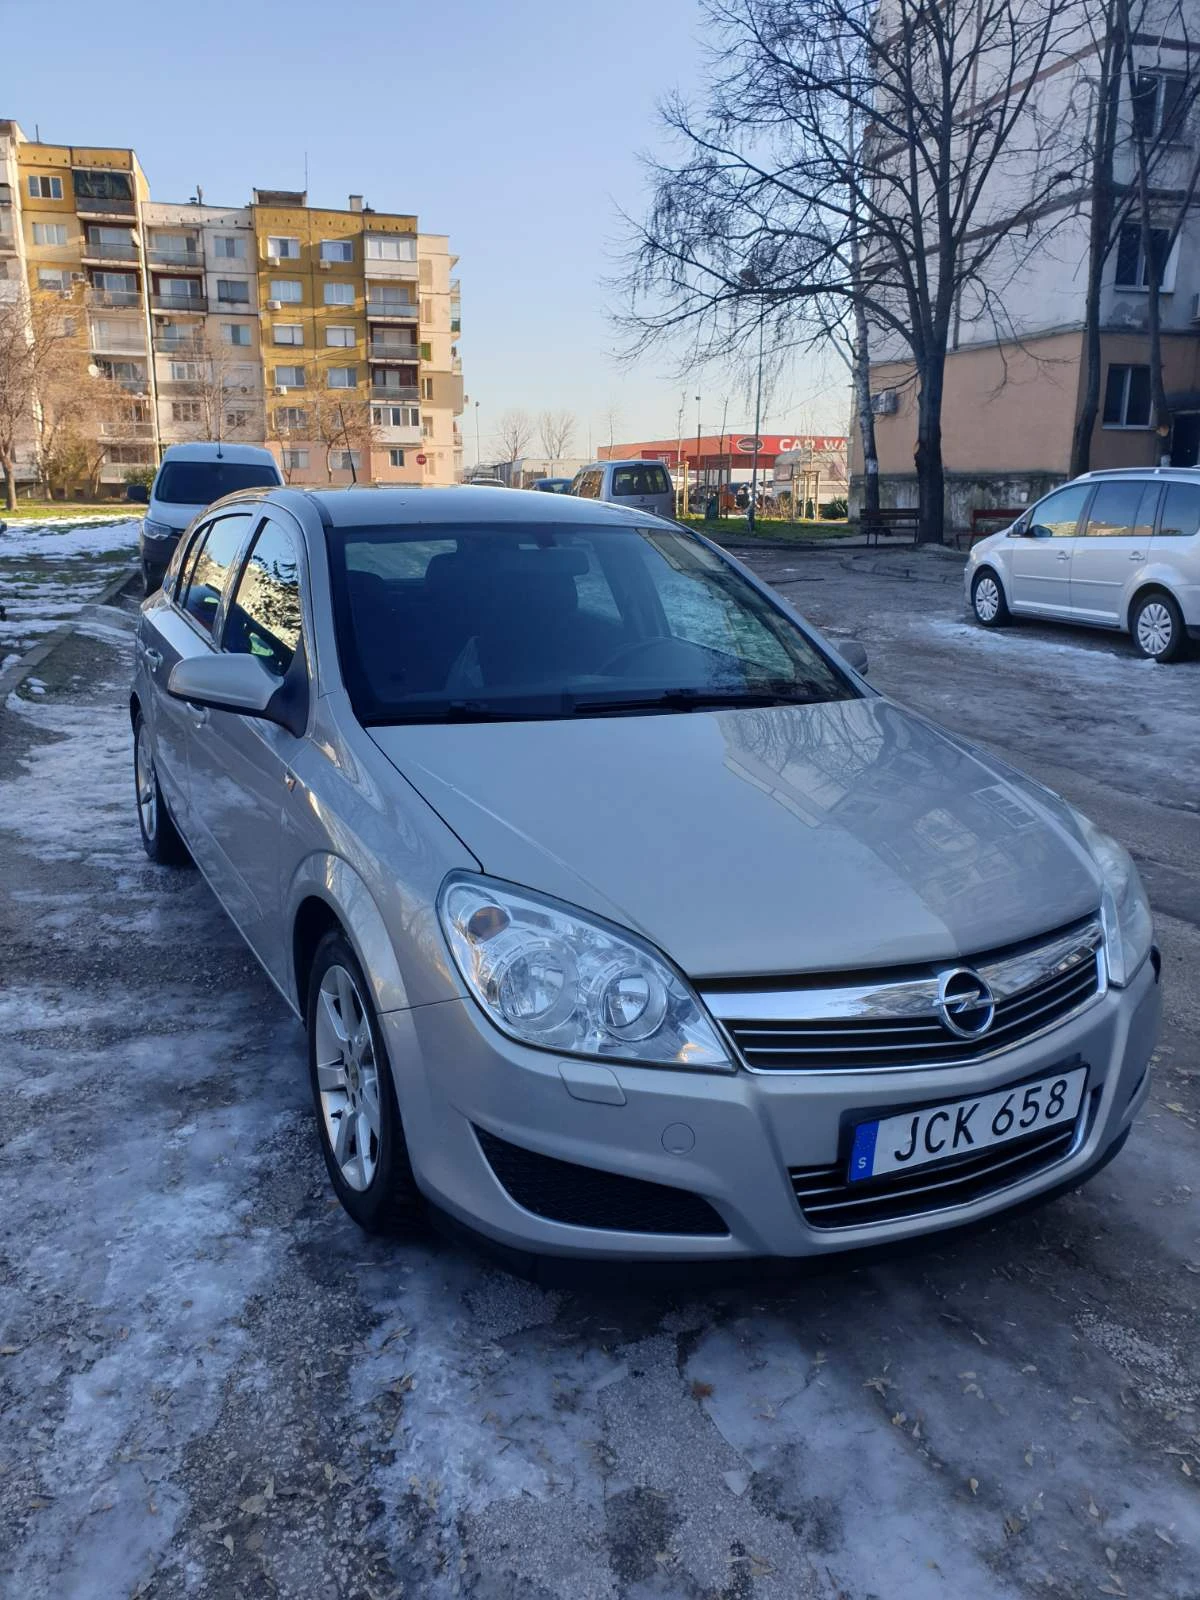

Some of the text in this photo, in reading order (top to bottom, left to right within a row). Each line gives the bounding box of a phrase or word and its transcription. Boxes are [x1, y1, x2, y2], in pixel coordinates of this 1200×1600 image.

[779, 438, 815, 451] CAR
[894, 1079, 1068, 1162] JCK 658
[858, 1156, 866, 1169] S
